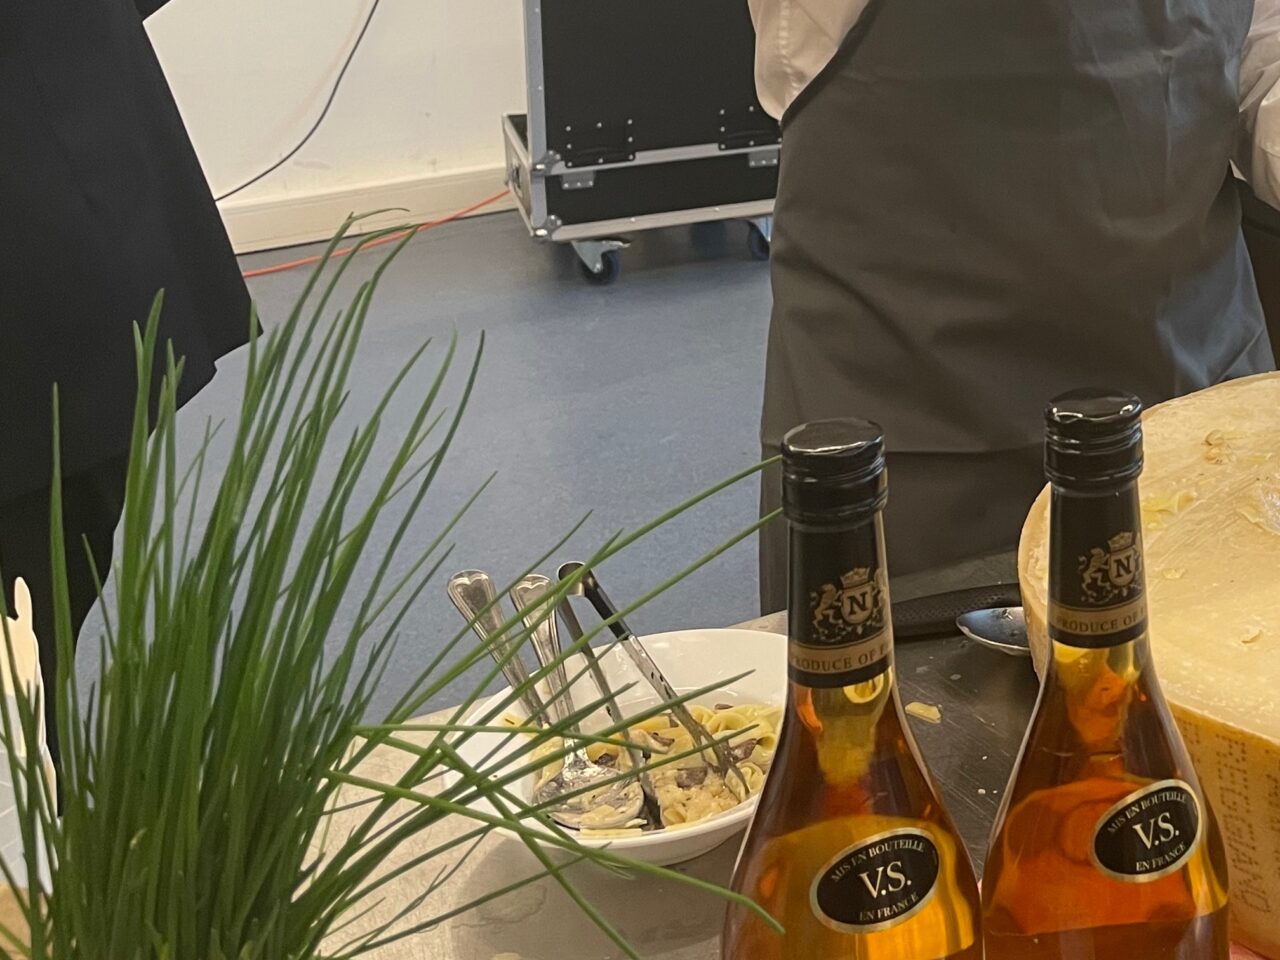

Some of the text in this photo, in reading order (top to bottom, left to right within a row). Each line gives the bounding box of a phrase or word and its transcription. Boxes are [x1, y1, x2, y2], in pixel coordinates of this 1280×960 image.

[1114, 555, 1133, 579] N
[848, 591, 869, 616] N
[1125, 803, 1140, 819] EN
[1140, 790, 1188, 810] BOUTEILLE
[1132, 812, 1180, 849] V.S.
[868, 839, 925, 858] BOUTEILLE
[1136, 841, 1187, 872] EN FRANCE
[858, 860, 912, 899] V.S.
[876, 891, 920, 919] FRANCE
